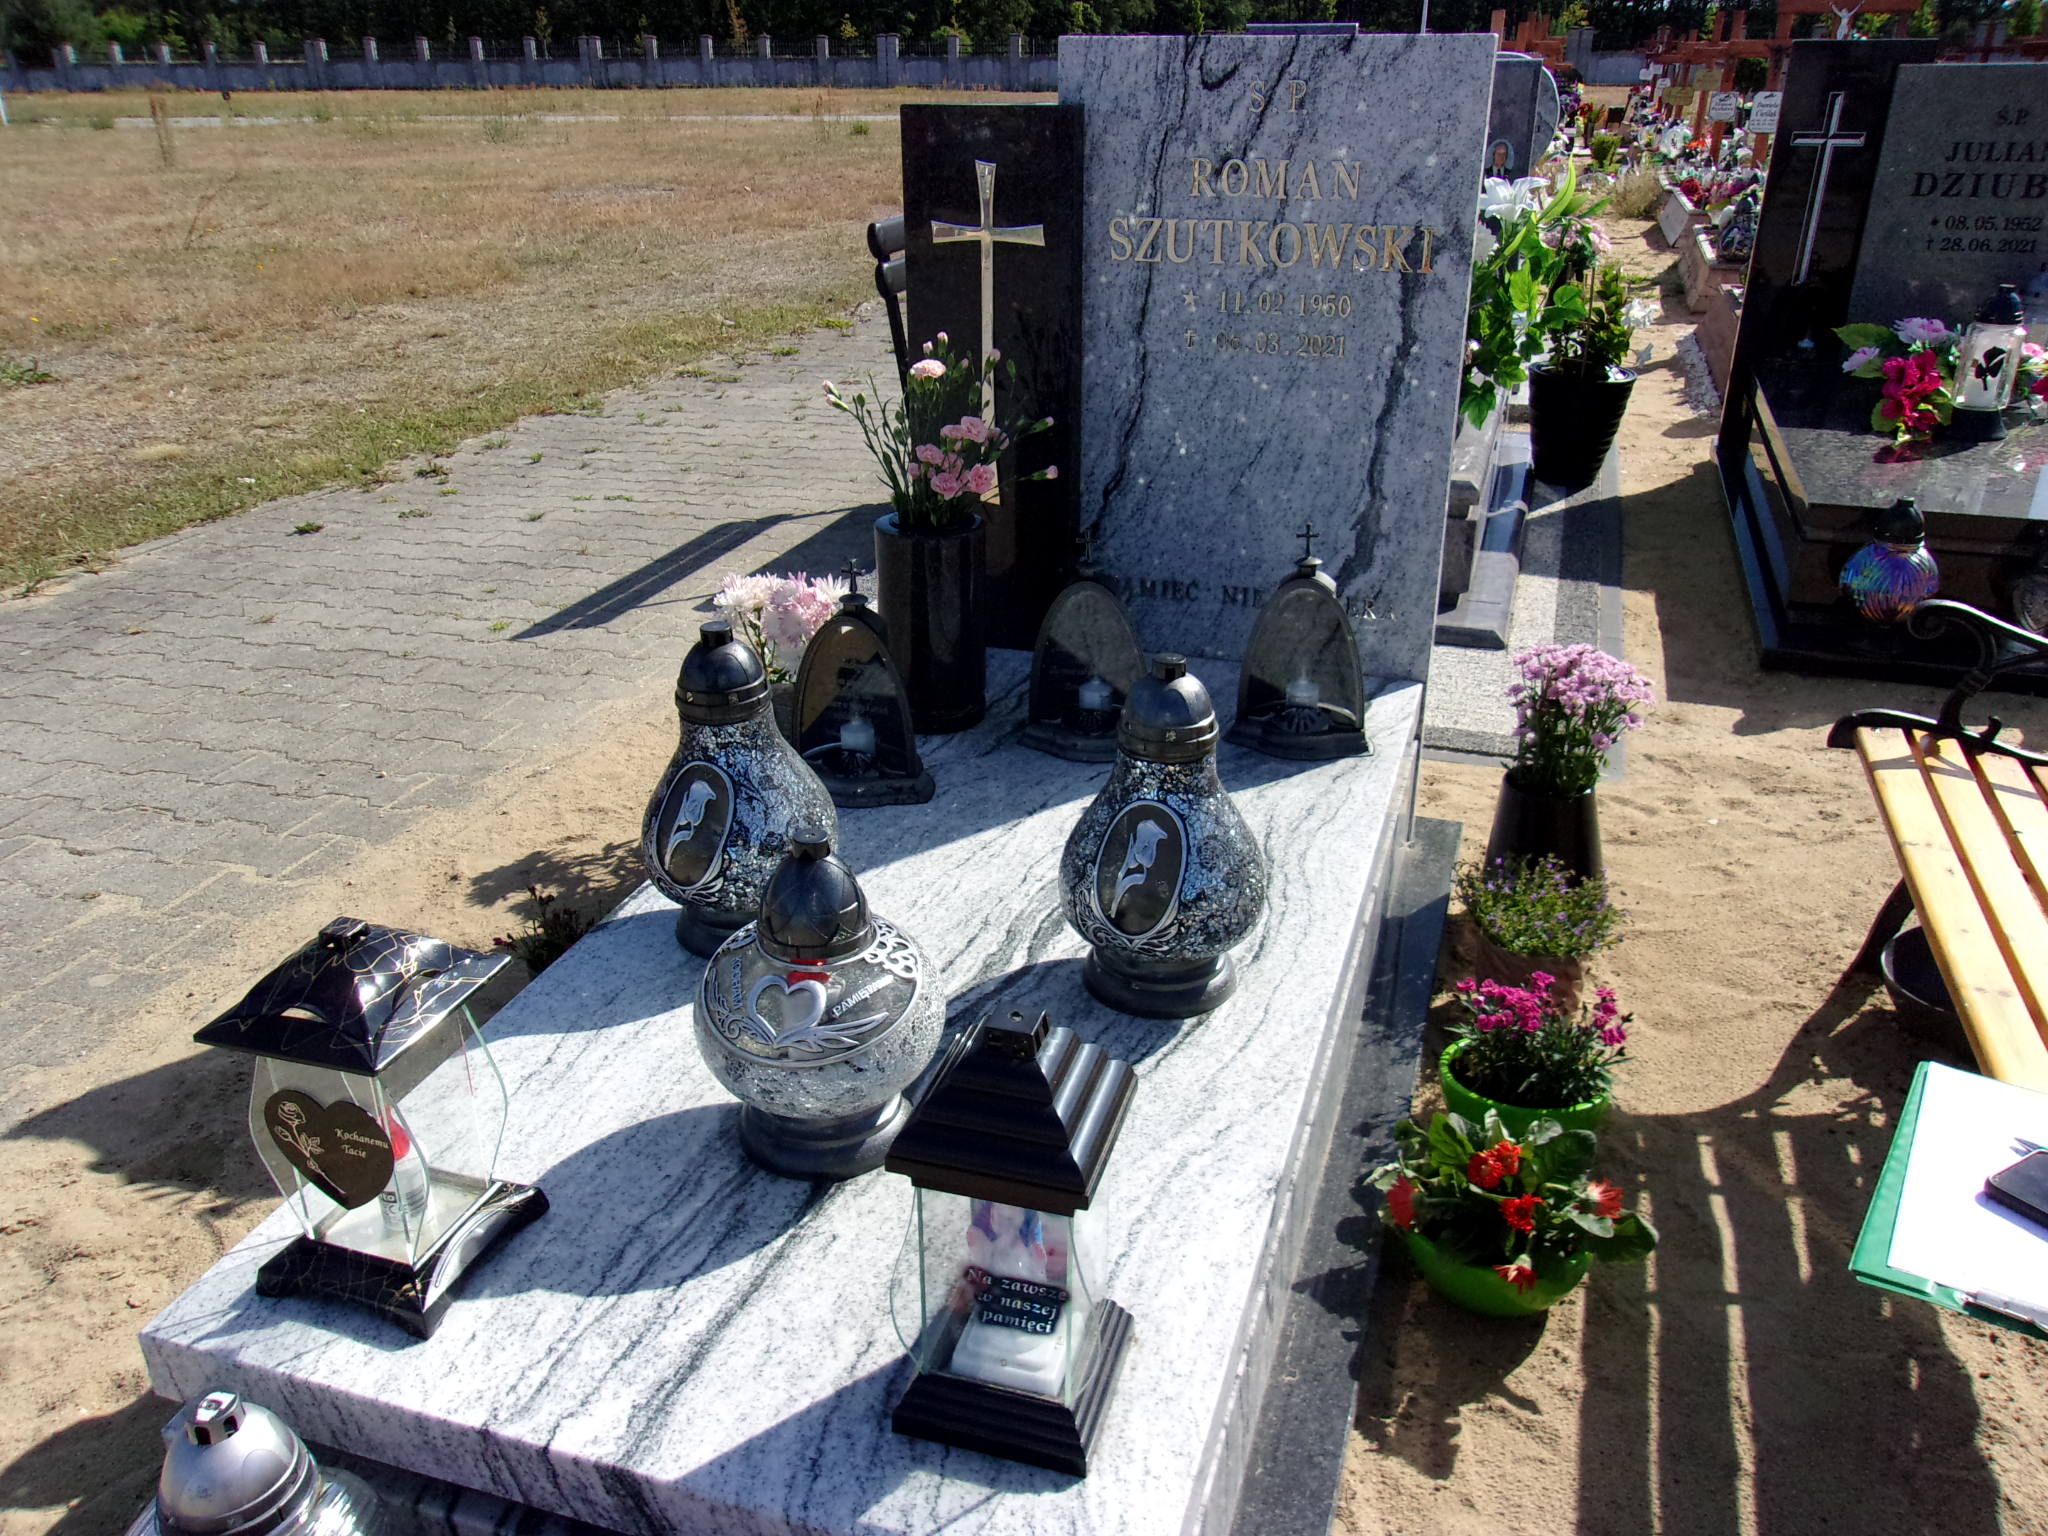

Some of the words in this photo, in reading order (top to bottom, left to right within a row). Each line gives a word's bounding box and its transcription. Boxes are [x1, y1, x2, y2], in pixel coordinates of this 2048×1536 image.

[1189, 157, 1361, 200] ROMAN
[1108, 217, 1438, 274] SZUTKOWSKI
[334, 1128, 389, 1149] Kochanemu
[341, 1144, 367, 1158] Tacie
[966, 1267, 992, 1285] Na
[1000, 1278, 1068, 1300] zawsze
[1000, 1295, 1058, 1319] naszej
[982, 1310, 1053, 1334] pamięci
